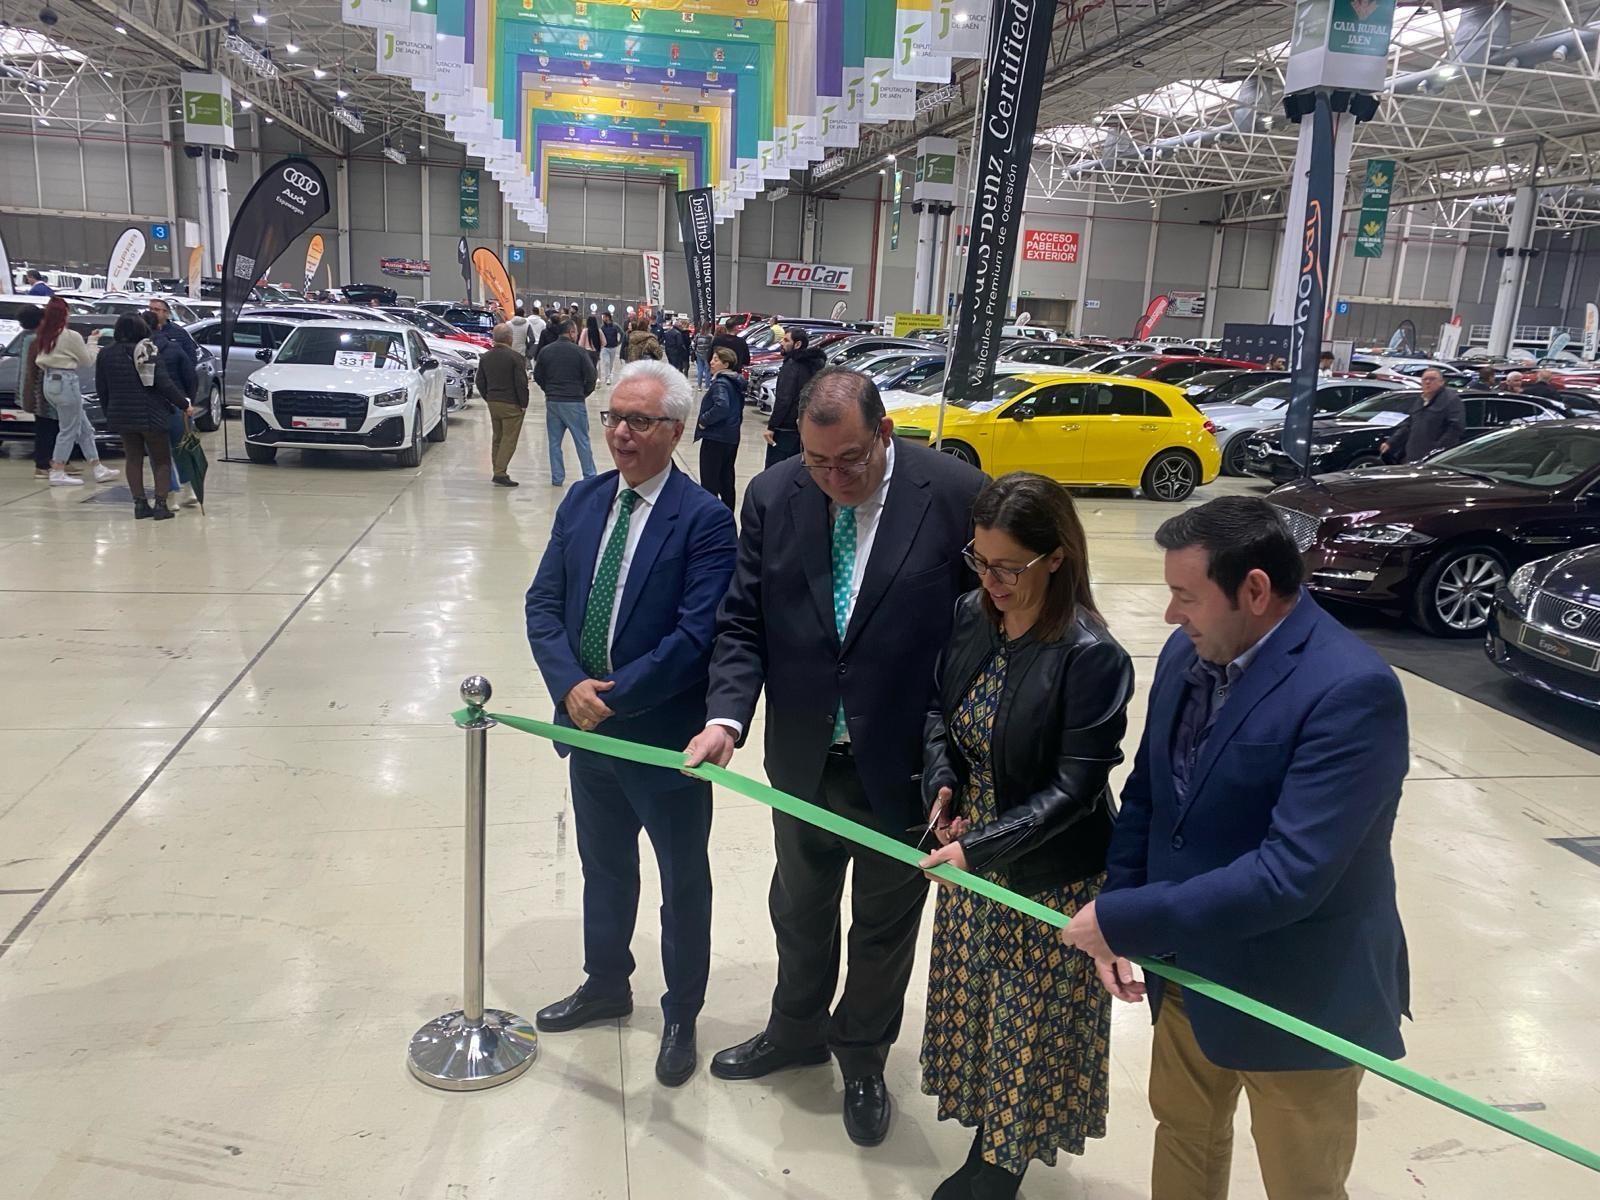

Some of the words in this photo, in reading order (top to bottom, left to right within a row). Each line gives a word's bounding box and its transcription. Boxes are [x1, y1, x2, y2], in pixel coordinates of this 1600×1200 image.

[1357, 23, 1389, 36] RURAL
[436, 61, 462, 69] UTACIÓN
[989, 0, 1030, 141] Certified
[282, 188, 307, 206] Audi
[1001, 162, 1019, 223] ocasión
[156, 226, 165, 238] 3
[997, 226, 1007, 246] de
[1032, 232, 1073, 243] ACCESO
[1026, 240, 1077, 253] PABELLON
[513, 250, 521, 261] 5
[1026, 250, 1075, 262] EXTERIOR
[649, 255, 661, 305] ProCar
[773, 263, 849, 284] ProCar
[985, 250, 1004, 316] Premium
[971, 319, 993, 387] Vehículos
[339, 357, 365, 367] 331
